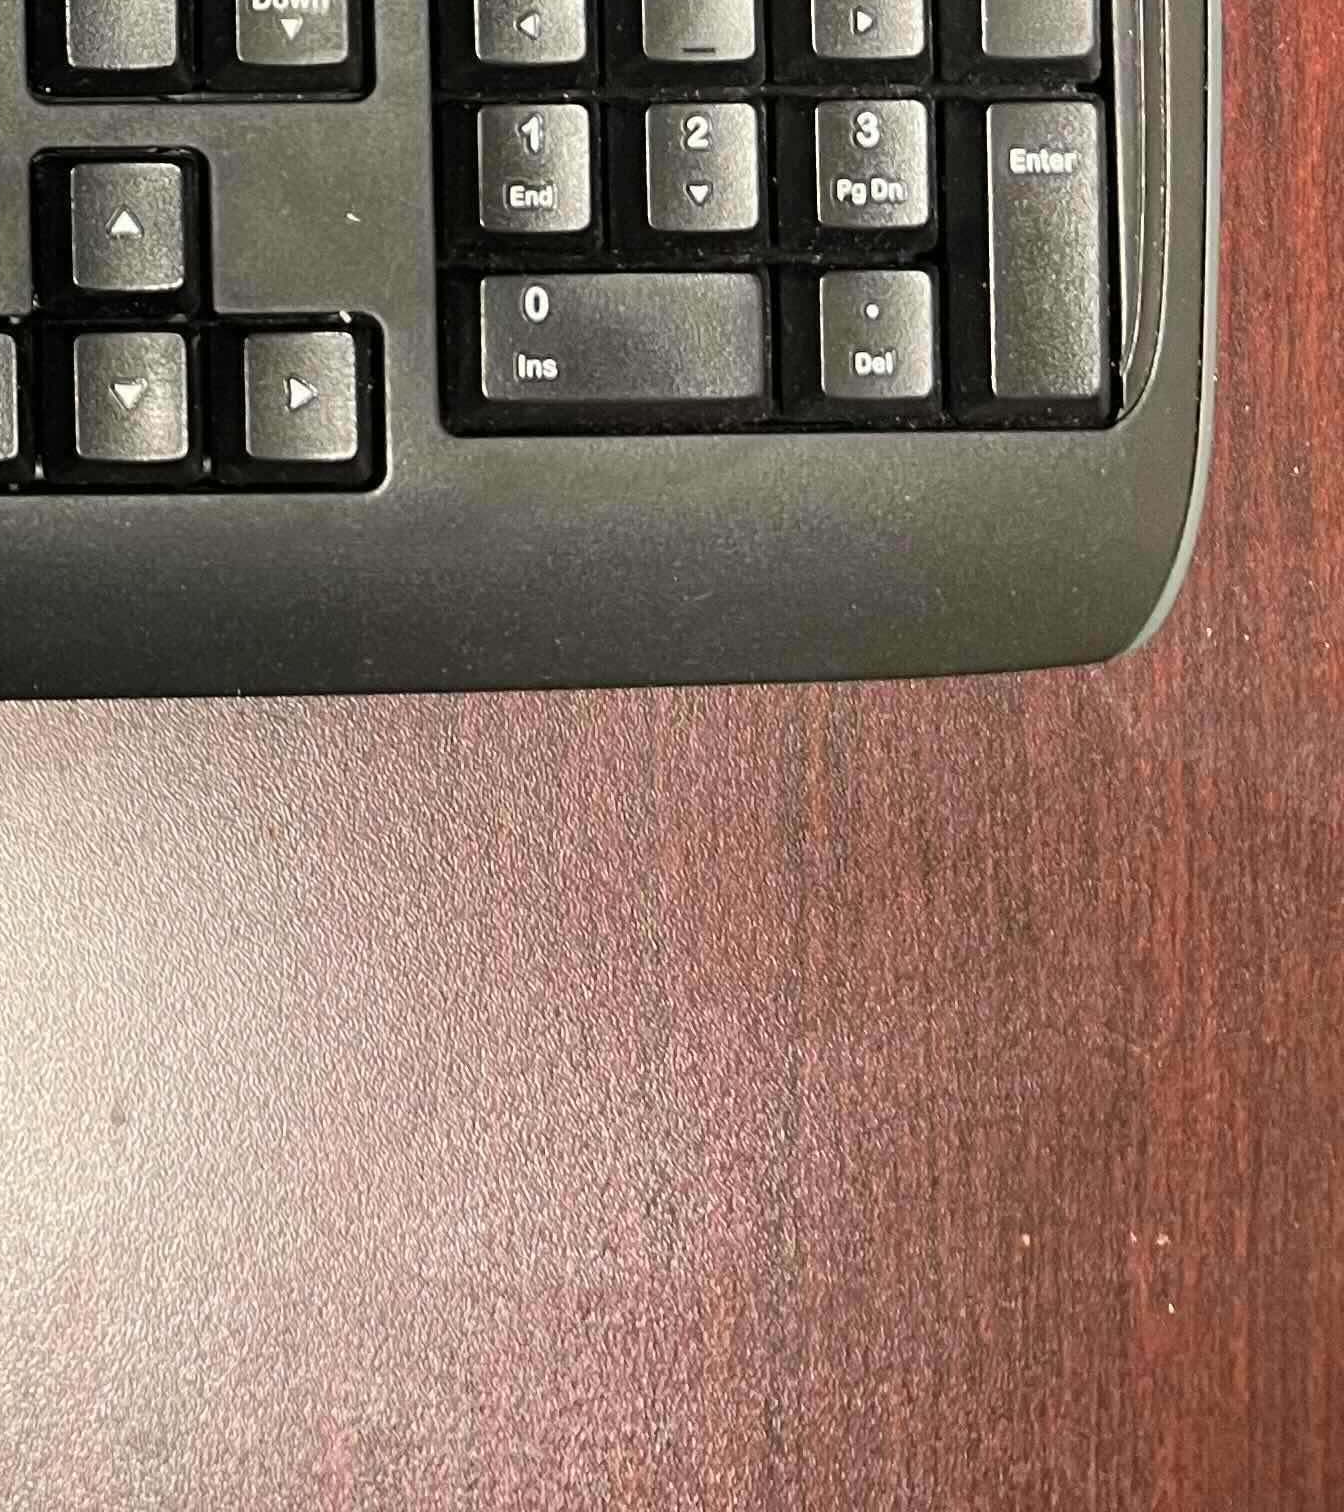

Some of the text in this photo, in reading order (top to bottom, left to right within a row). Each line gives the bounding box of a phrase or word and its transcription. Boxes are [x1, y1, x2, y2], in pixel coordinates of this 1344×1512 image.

[522, 117, 539, 151] 1
[686, 117, 710, 149] 2
[855, 114, 879, 147] 3
[1009, 148, 1076, 172] Enter
[510, 185, 553, 206] End
[837, 179, 904, 205] Pg Dn
[525, 289, 549, 321] 0
[518, 354, 557, 377] Ins
[856, 353, 894, 375] Del
